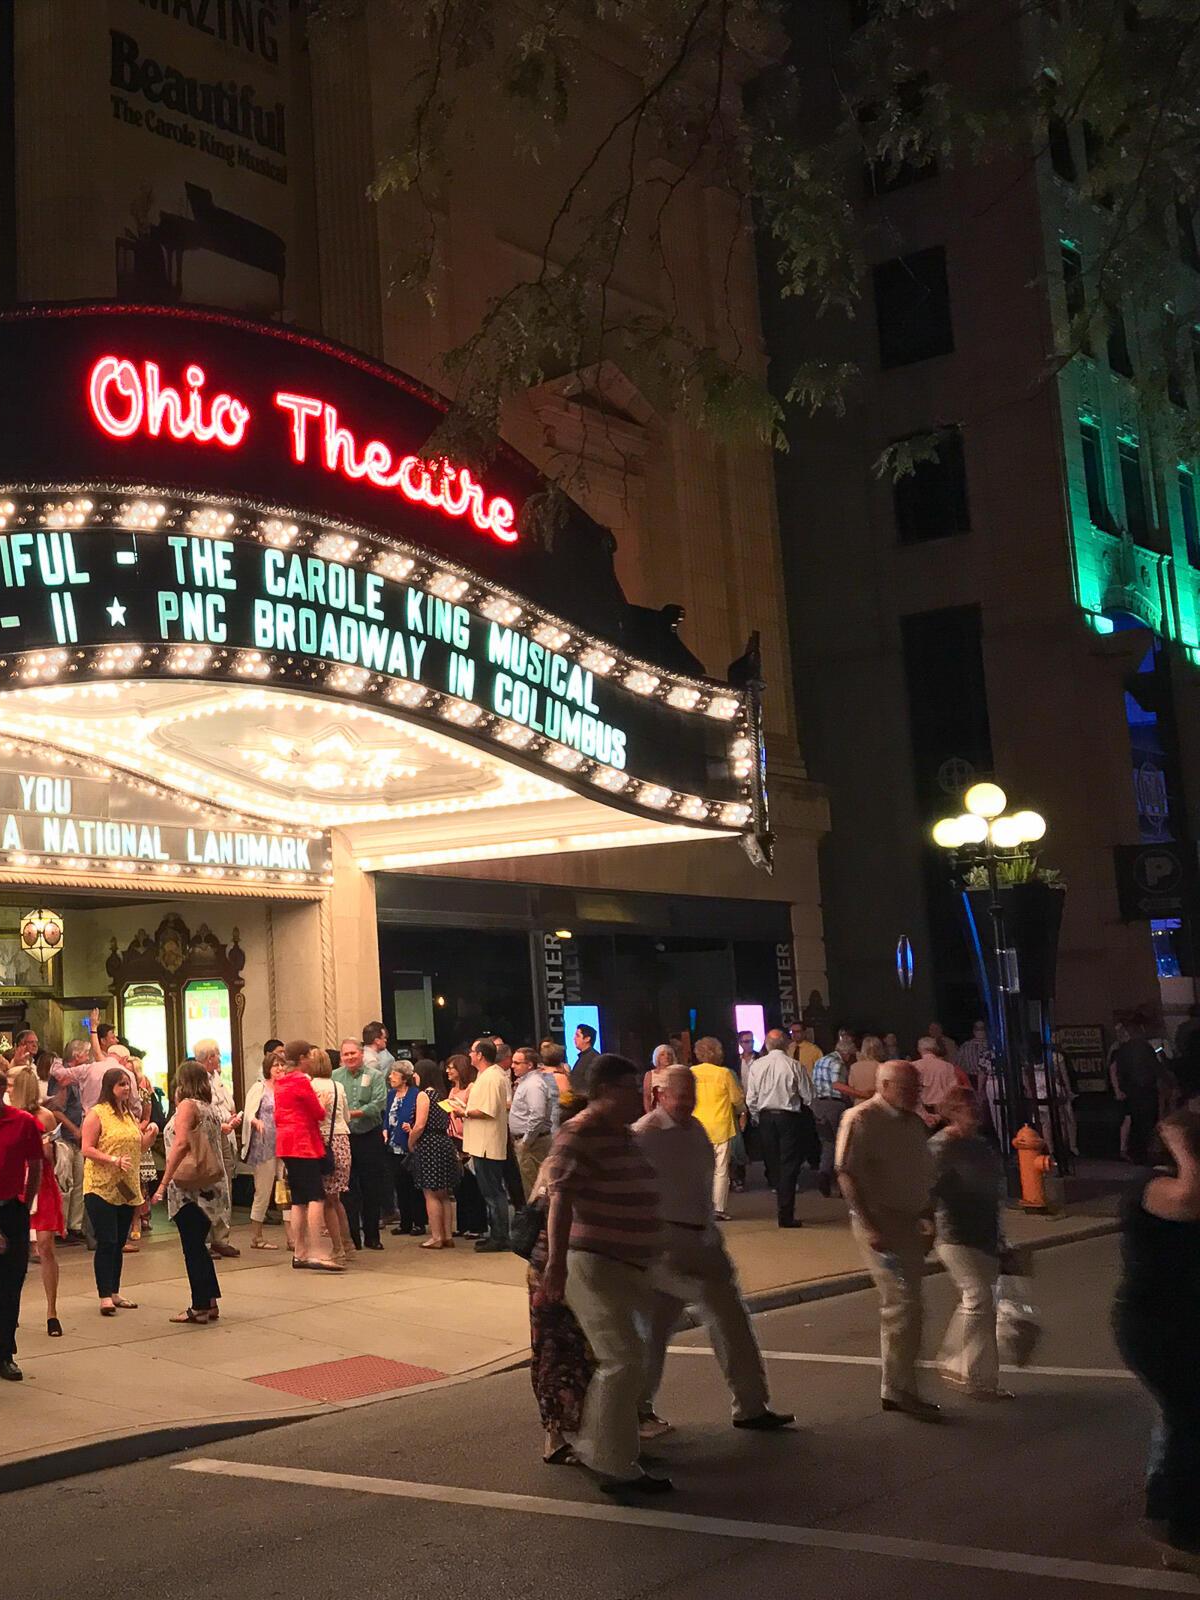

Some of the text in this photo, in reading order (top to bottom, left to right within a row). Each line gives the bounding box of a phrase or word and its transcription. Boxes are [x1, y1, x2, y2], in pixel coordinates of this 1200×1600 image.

[110, 29, 287, 156] Beautiful
[110, 94, 287, 185] The Carole King Musical
[91, 355, 518, 543] Ohio Theatre
[158, 591, 228, 643] PNC
[254, 600, 427, 681] BROADWAY
[448, 654, 475, 701] IN
[494, 672, 628, 770] COLUMBUS
[167, 536, 237, 591] THE
[264, 548, 385, 622] CAROLE
[406, 585, 470, 650] KING
[488, 627, 600, 715] MUSICAL
[2, 815, 22, 850] A
[43, 818, 170, 862] NATIONAL
[187, 828, 312, 870] LANDMARK
[18, 774, 72, 815] YOU
[543, 933, 565, 1032] CENTER
